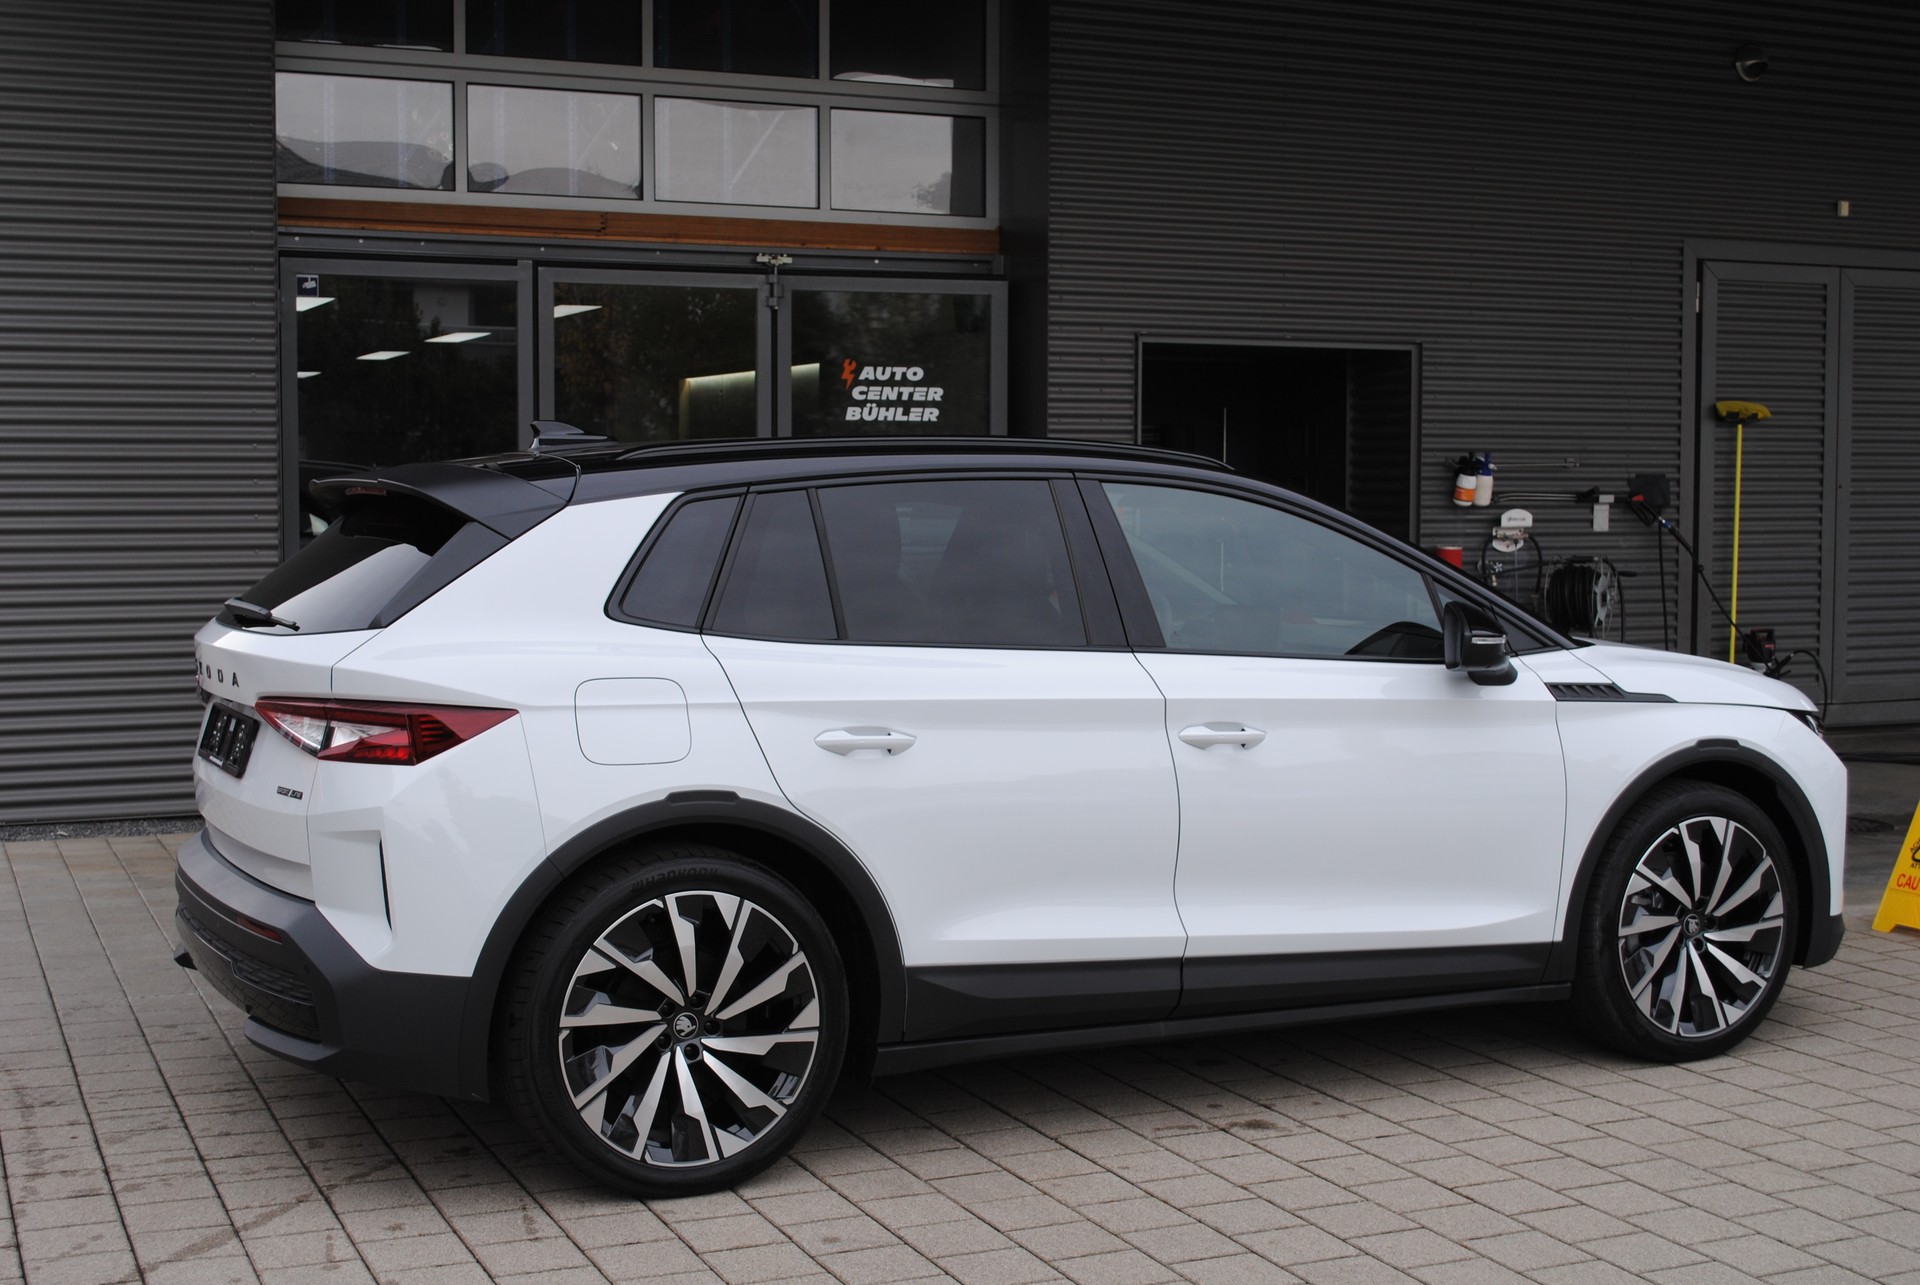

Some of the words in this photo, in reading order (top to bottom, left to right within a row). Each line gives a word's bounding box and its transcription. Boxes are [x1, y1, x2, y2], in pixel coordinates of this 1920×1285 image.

[858, 366, 924, 381] AUTO
[851, 385, 944, 401] CENTER
[845, 403, 940, 421] BÜHLER
[195, 658, 239, 688] ODA
